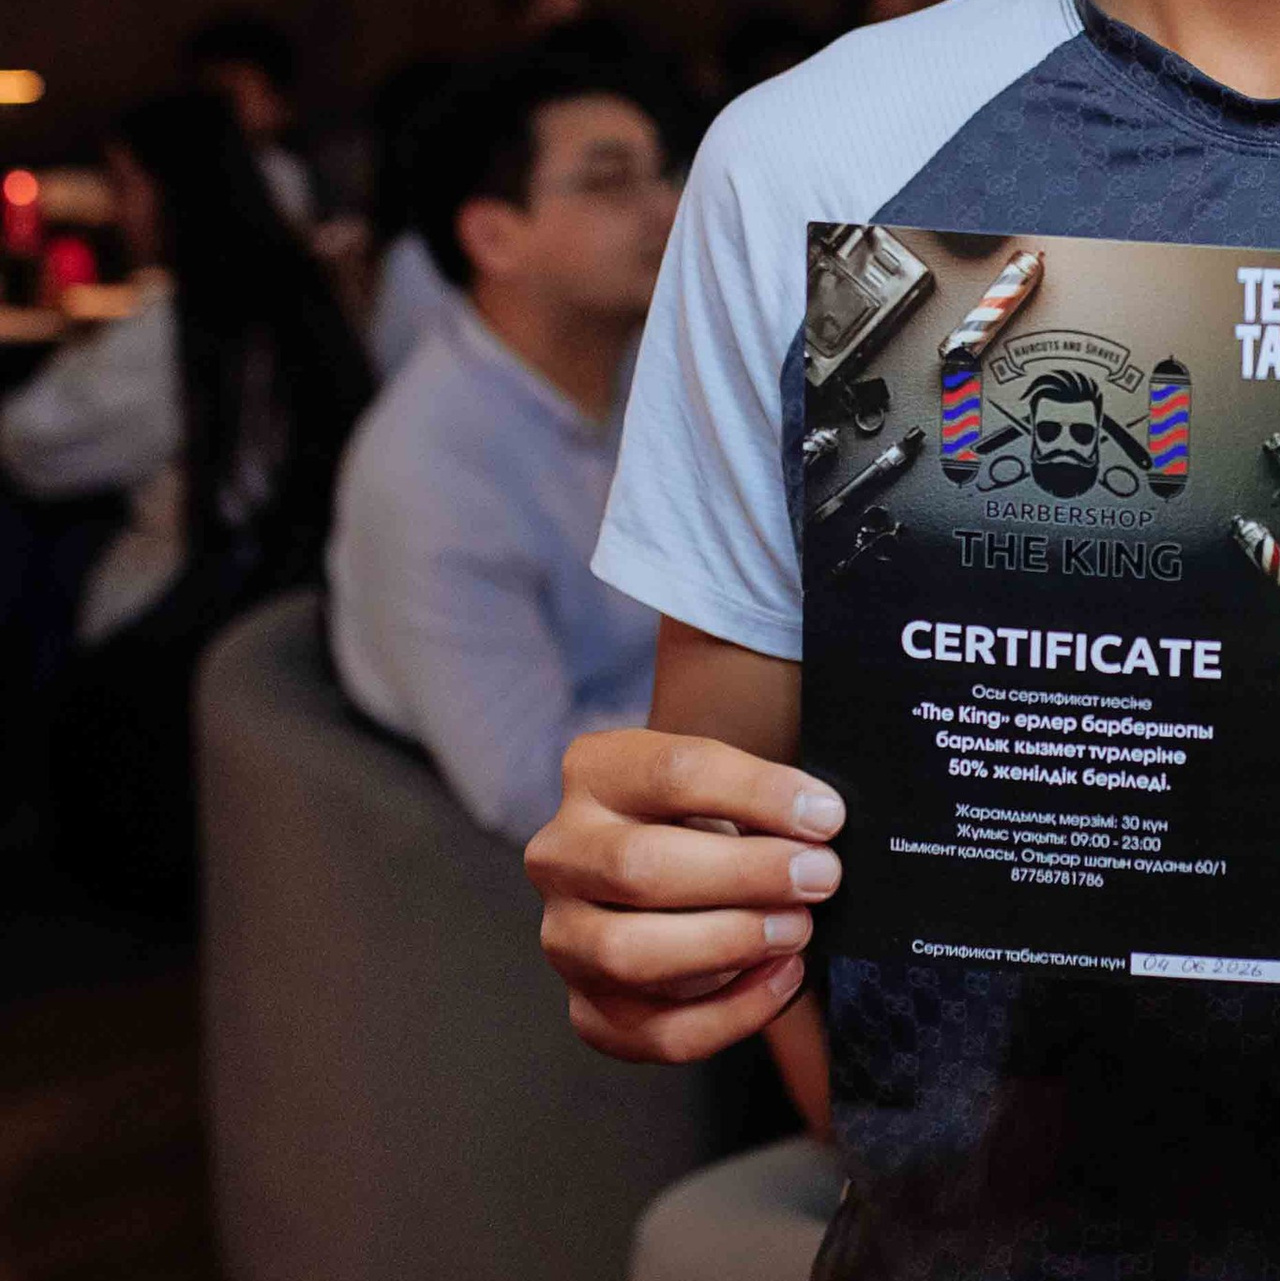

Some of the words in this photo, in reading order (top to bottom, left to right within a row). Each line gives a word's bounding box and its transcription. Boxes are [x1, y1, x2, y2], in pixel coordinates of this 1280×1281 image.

[1013, 340, 1059, 358] HAIRCUTS
[1063, 340, 1082, 352] AND
[1086, 343, 1121, 365] SHAVES
[986, 500, 1153, 527] BARBERSHOP
[952, 529, 1051, 571] THE
[1062, 536, 1183, 582] KING
[901, 620, 1222, 680] CERTIFICATE
[972, 684, 1006, 700] Осы
[1009, 689, 1099, 708] сертификат
[1101, 695, 1152, 710] иесіне
[912, 702, 954, 721] «The
[959, 705, 1010, 729] King»
[1014, 713, 1077, 734] ерлер
[1081, 714, 1214, 739] барбершопы
[948, 758, 989, 778] 50%
[1082, 768, 1171, 792] беріледі.
[955, 803, 1056, 826] Жарамдылық
[1059, 812, 1118, 829] мерзімі:
[1121, 815, 1140, 830] 30
[1070, 832, 1110, 848] 09:00
[1121, 835, 1161, 852] 23:00
[890, 837, 955, 857] Шымкент
[1021, 848, 1081, 867] Отырар
[1134, 858, 1192, 874] ауданы
[1194, 859, 1226, 876] 60/1
[911, 939, 1003, 960] Сертификат
